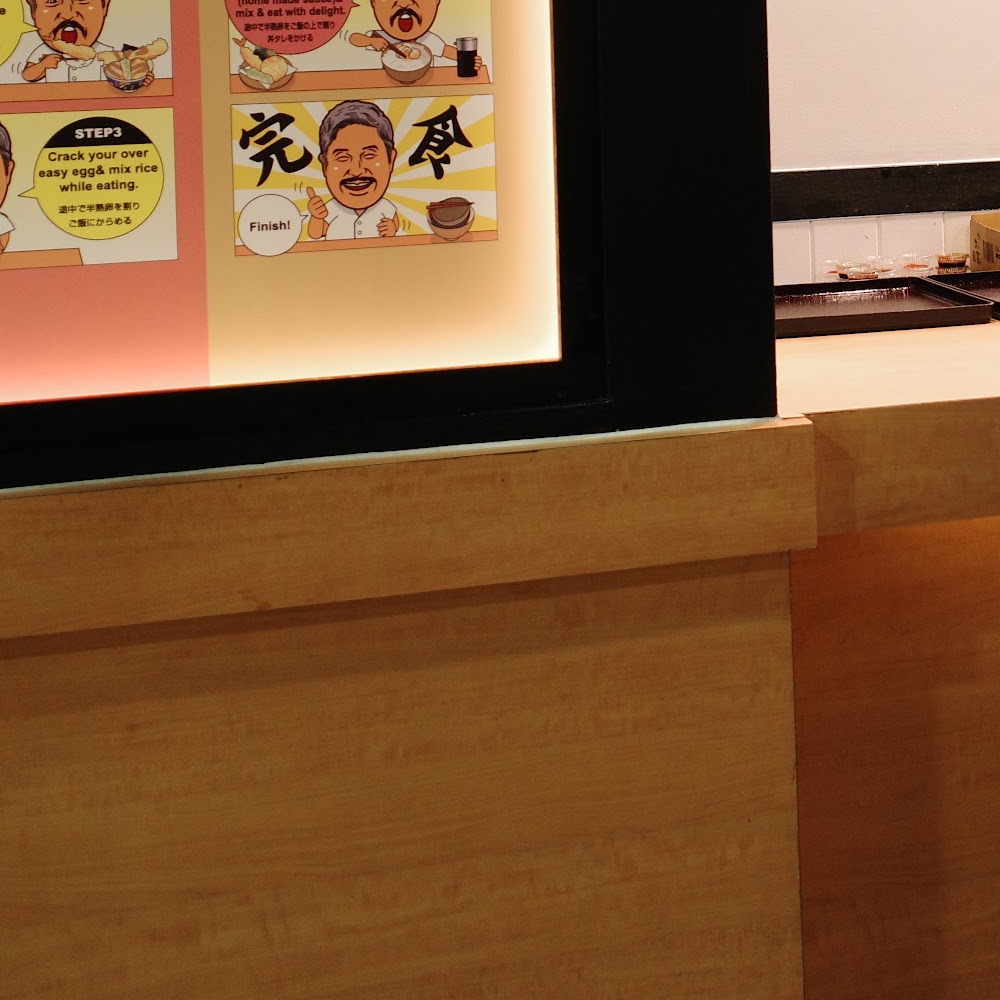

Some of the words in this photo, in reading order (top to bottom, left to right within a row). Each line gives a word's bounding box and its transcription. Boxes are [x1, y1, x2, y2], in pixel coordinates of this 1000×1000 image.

[235, 7, 254, 18] mix
[257, 8, 265, 17] &
[267, 7, 283, 17] eat
[285, 6, 308, 16] with
[309, 6, 346, 17] delight.
[74, 126, 123, 139] STEP3
[239, 112, 313, 187] 完
[408, 104, 473, 180] 食
[47, 150, 85, 162] Crack
[88, 150, 118, 163] your
[120, 149, 149, 159] over
[38, 168, 68, 180] easy
[109, 163, 131, 175] mix
[135, 163, 158, 174] rice
[59, 181, 92, 193] while
[96, 179, 139, 192] eating.
[249, 219, 291, 233] Finish!
